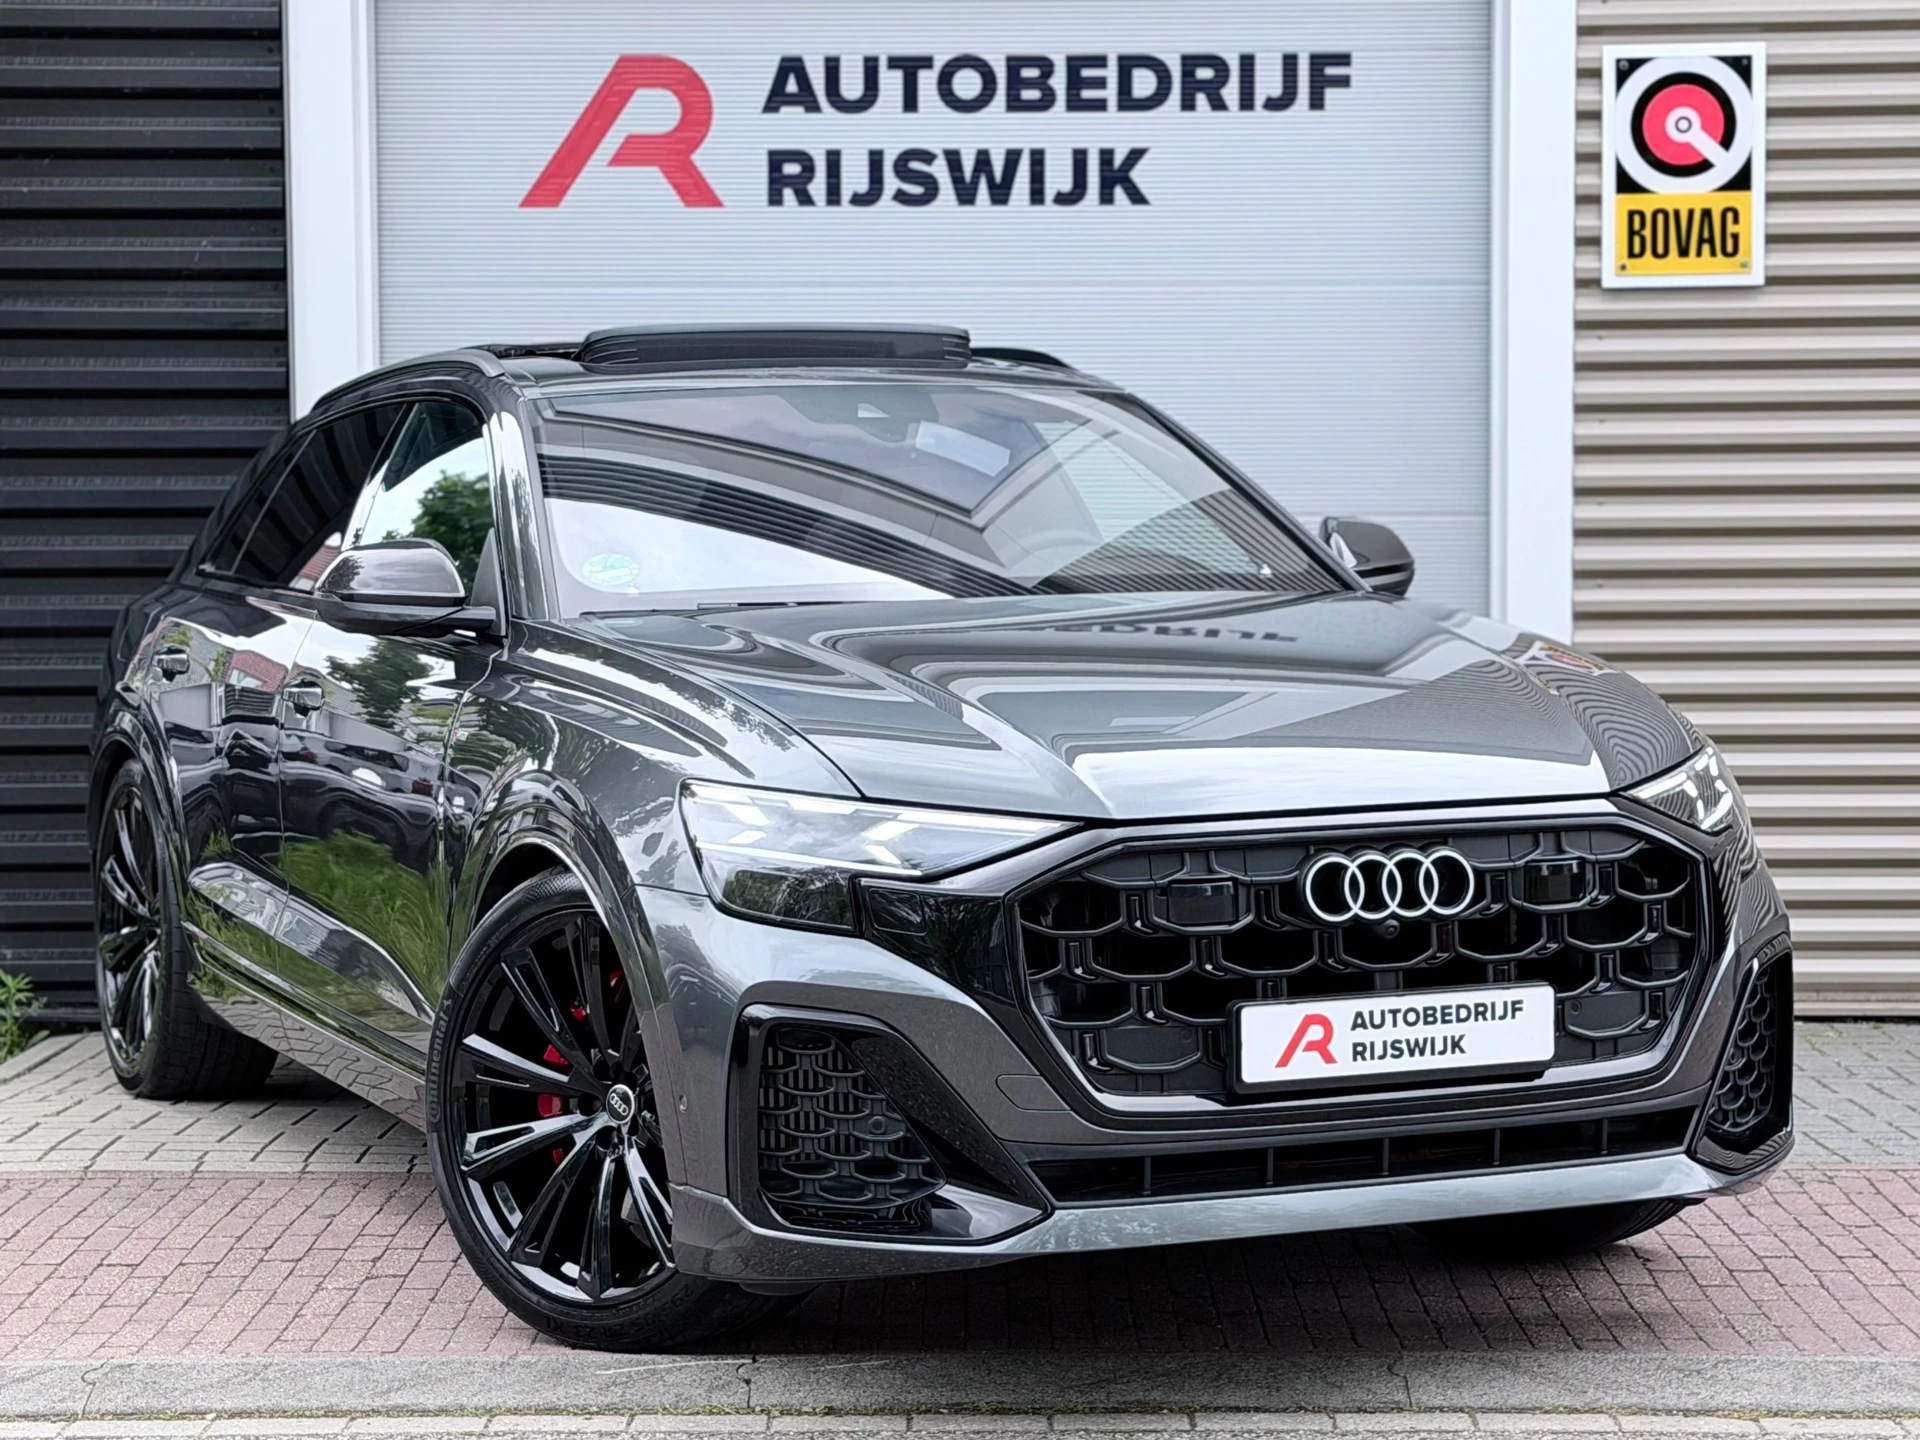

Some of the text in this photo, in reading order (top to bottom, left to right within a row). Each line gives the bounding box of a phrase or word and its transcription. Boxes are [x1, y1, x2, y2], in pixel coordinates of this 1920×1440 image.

[762, 53, 1352, 114] AUTOBEDRIJF
[767, 147, 1151, 206] RIJSWIJK
[1627, 206, 1740, 259] BOVAG
[1350, 999, 1524, 1031] AUTOBEDRIJF
[429, 1010, 449, 1122] Continental
[1351, 1034, 1467, 1062] RIJSWIJK
